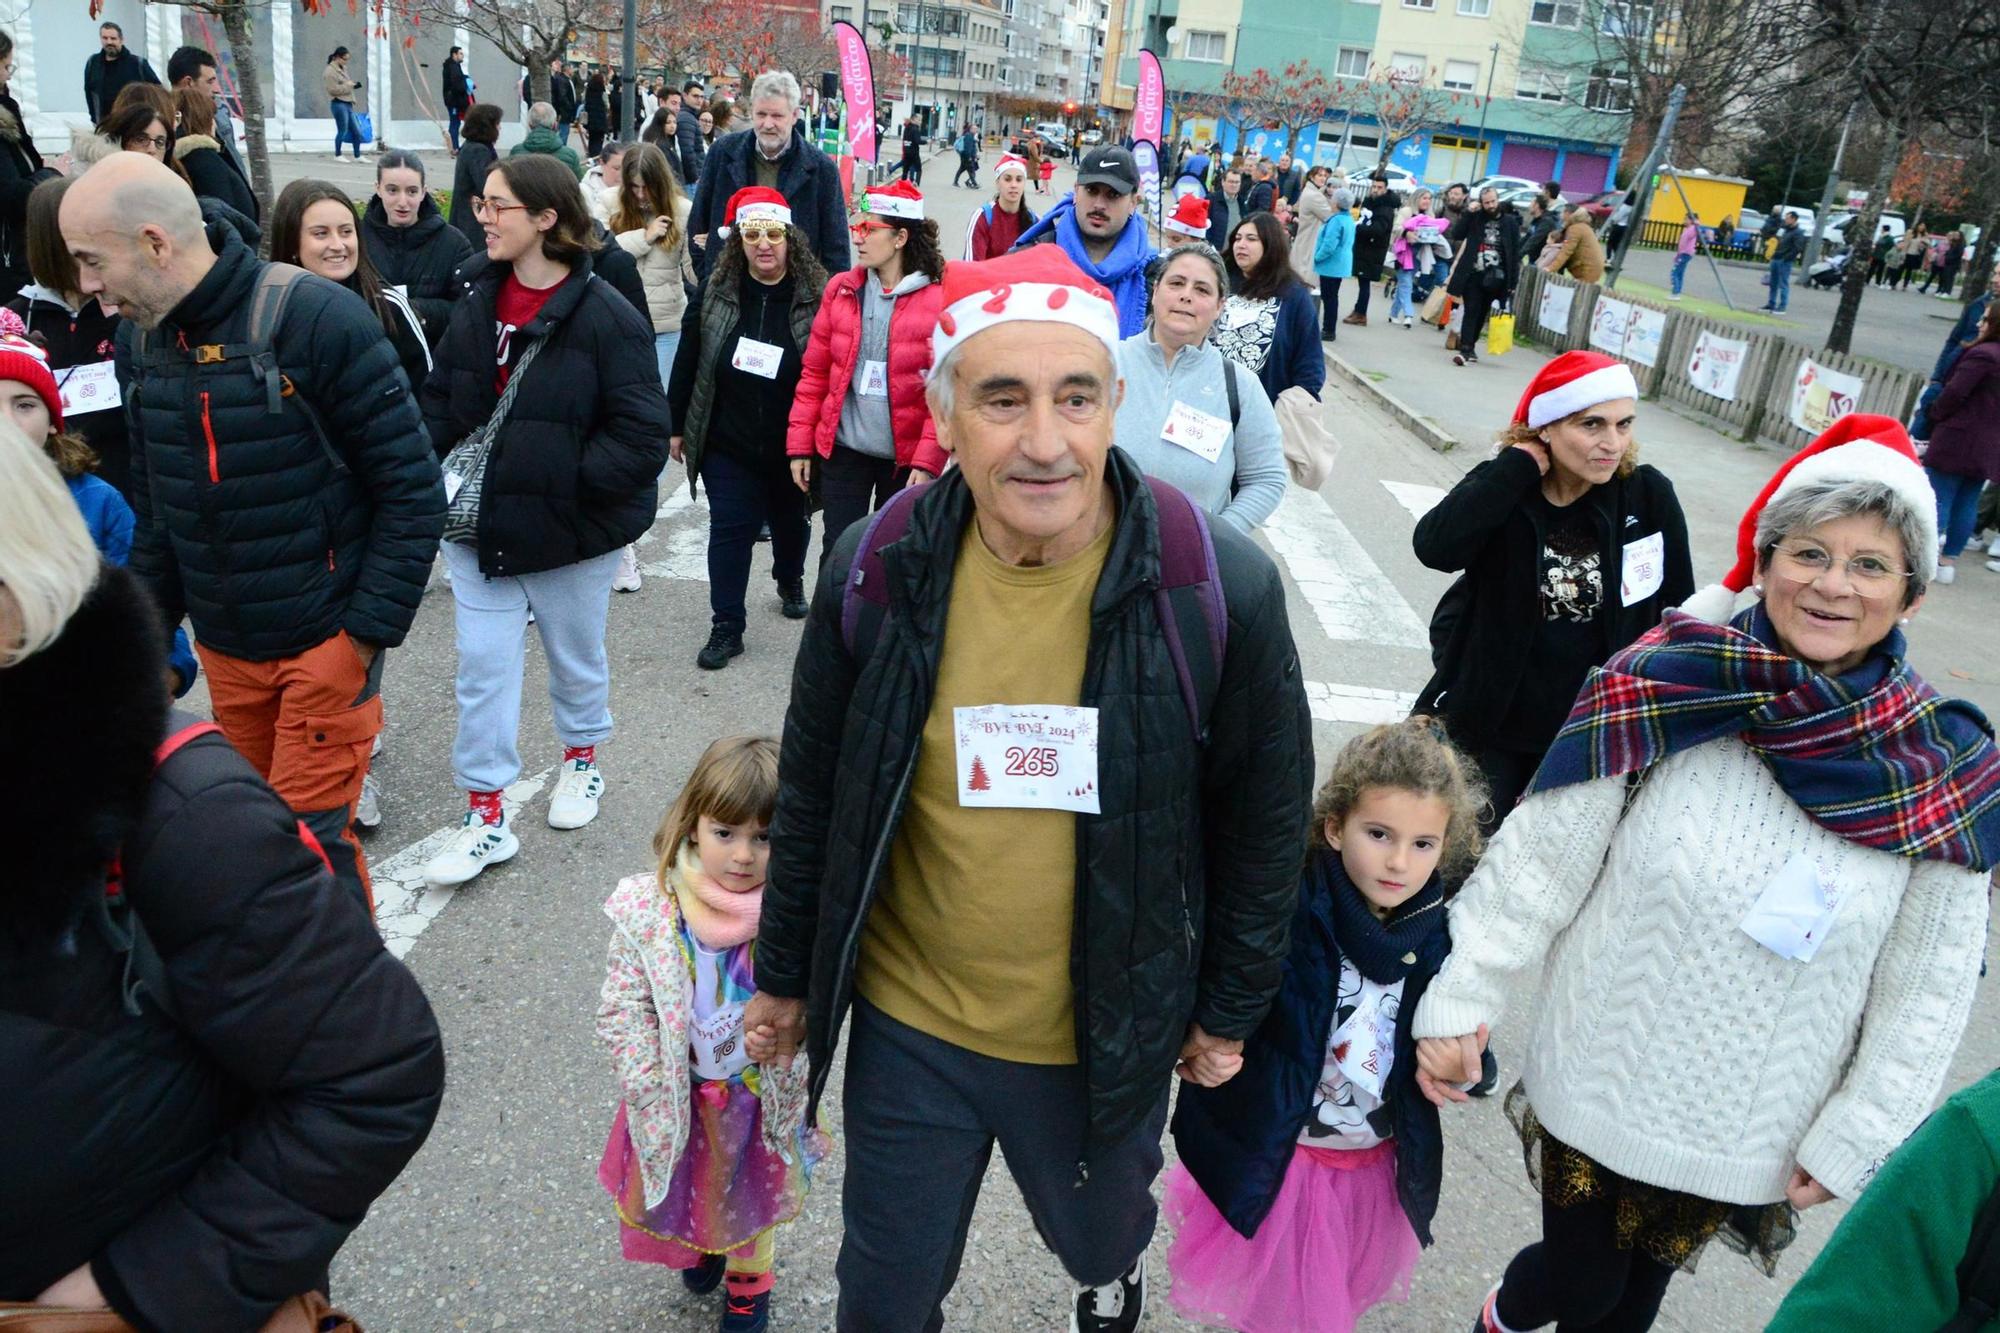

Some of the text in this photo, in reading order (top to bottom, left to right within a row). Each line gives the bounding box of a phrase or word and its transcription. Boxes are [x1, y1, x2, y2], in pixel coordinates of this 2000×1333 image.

[984, 722, 1075, 740] BYE BYE 2024
[1005, 746, 1059, 777] 265
